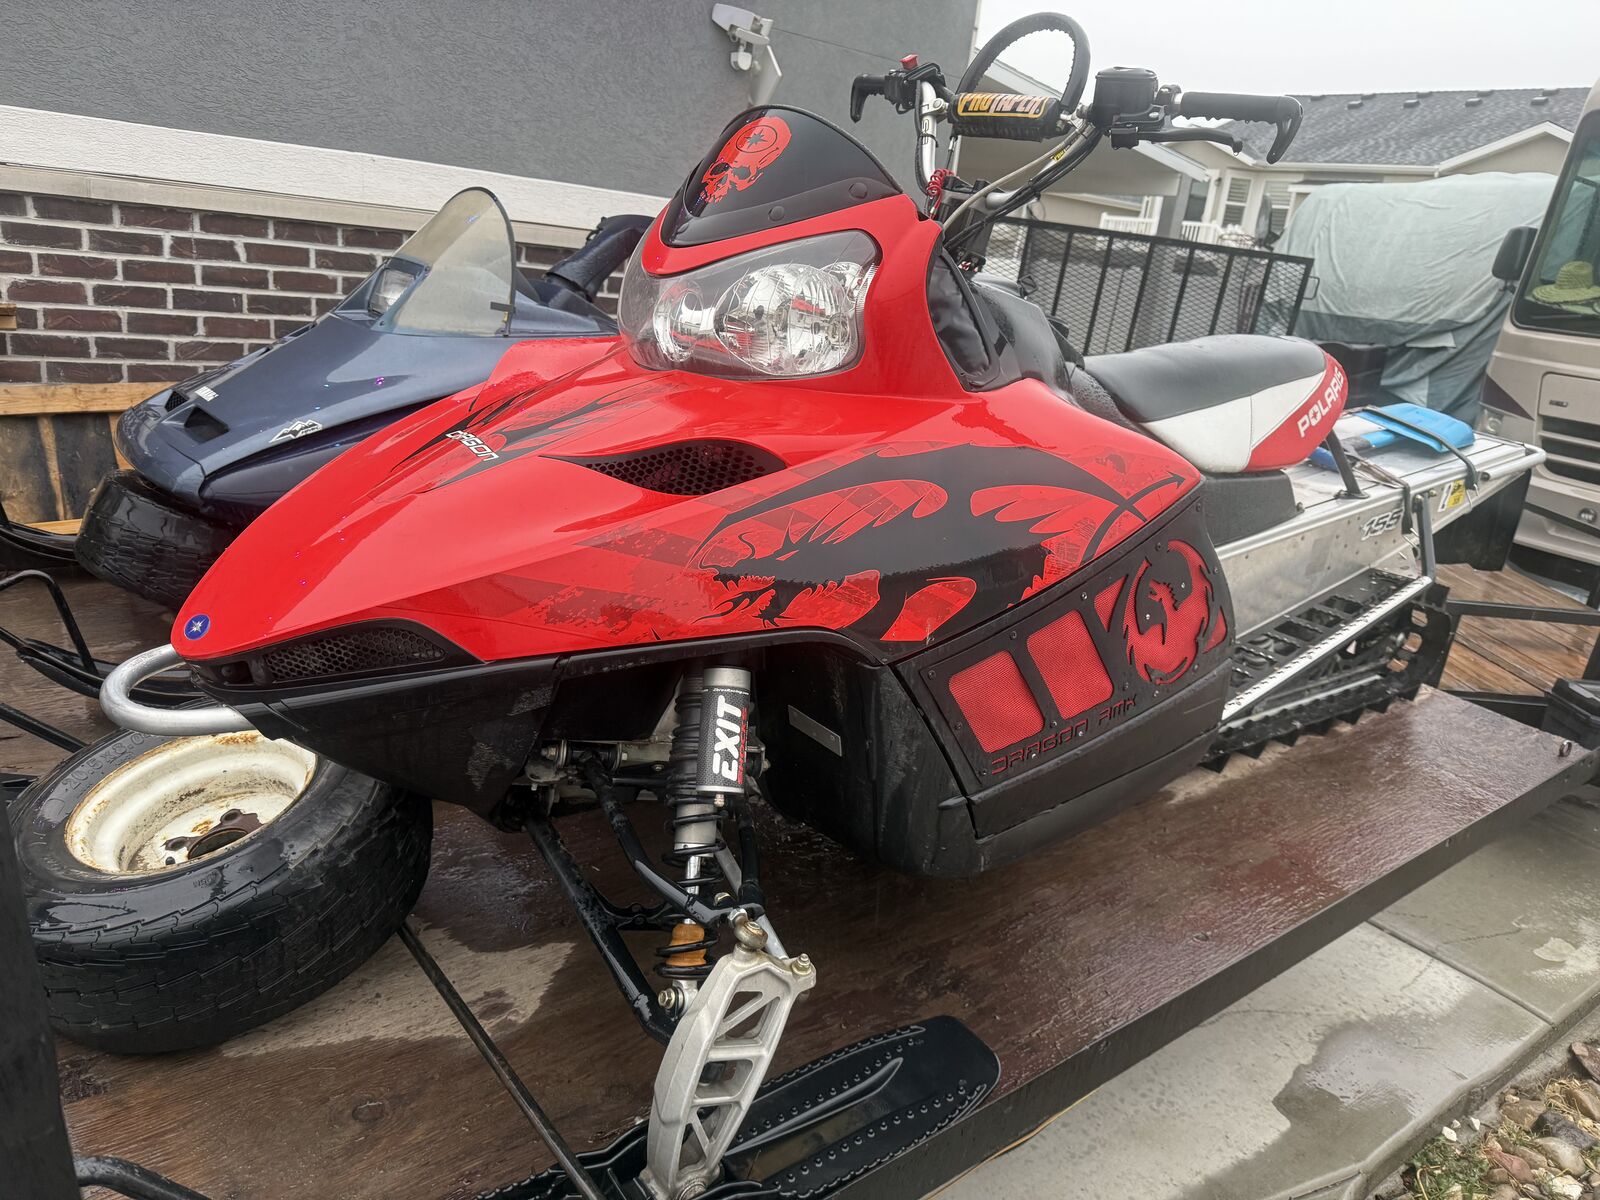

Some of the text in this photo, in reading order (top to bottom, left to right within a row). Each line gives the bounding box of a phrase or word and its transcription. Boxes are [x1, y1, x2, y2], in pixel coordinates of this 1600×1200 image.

[1297, 366, 1344, 438] POLARIS
[1361, 506, 1404, 541] 155
[712, 694, 742, 782] EXIT
[991, 693, 1137, 776] DRAGON RMK
